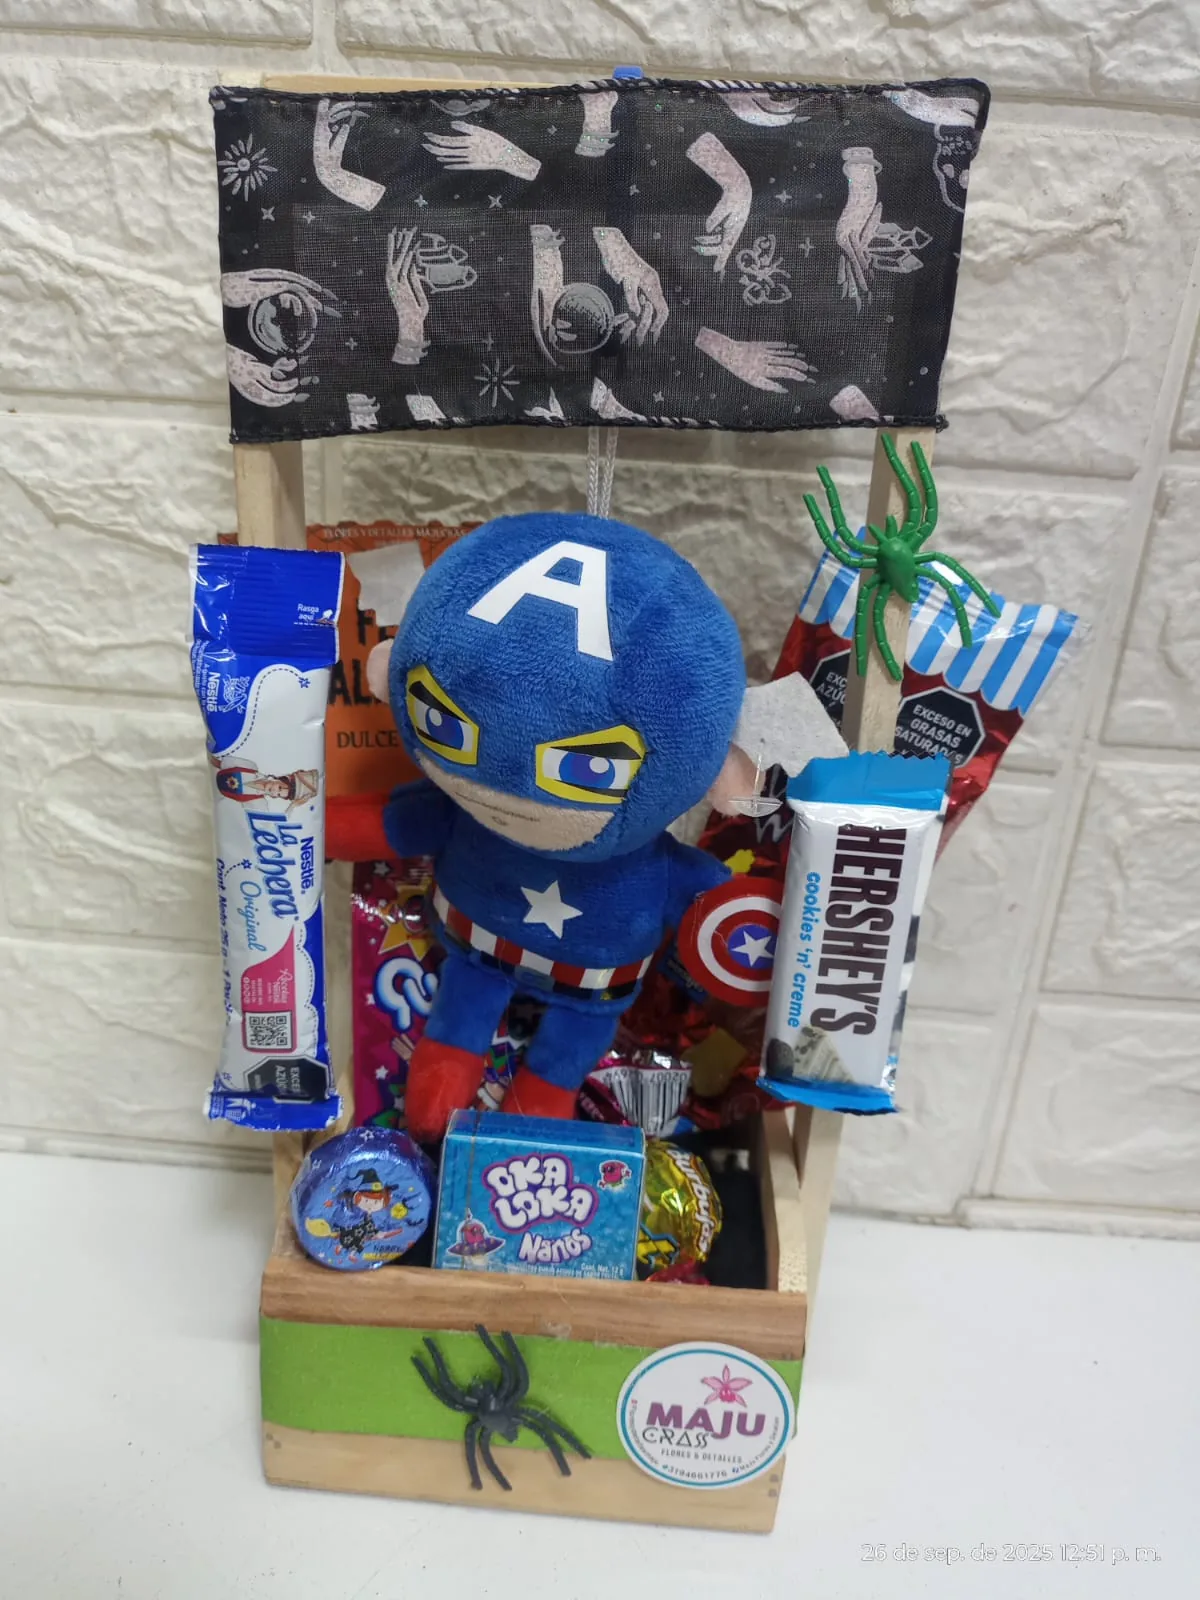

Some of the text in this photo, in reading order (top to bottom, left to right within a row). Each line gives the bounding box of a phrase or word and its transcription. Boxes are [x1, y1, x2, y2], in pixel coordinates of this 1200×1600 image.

[297, 603, 320, 615] Rasga
[467, 540, 613, 661] A
[825, 671, 848, 689] EXC
[909, 718, 963, 749] GRASAS
[912, 704, 973, 739] EXCESO EN
[278, 823, 303, 847] La
[246, 810, 300, 919] Lechera
[237, 881, 268, 952] Original
[799, 871, 821, 942] cookies
[809, 823, 908, 1036] HERSHEY'S
[787, 972, 808, 1028] creme
[486, 1154, 570, 1197] OKA
[495, 1185, 595, 1230] LOKA
[518, 1228, 593, 1264] Nanos
[646, 1402, 766, 1440] MAJU
[661, 1448, 690, 1460] FLORES
[702, 1453, 742, 1464] DETALLES
